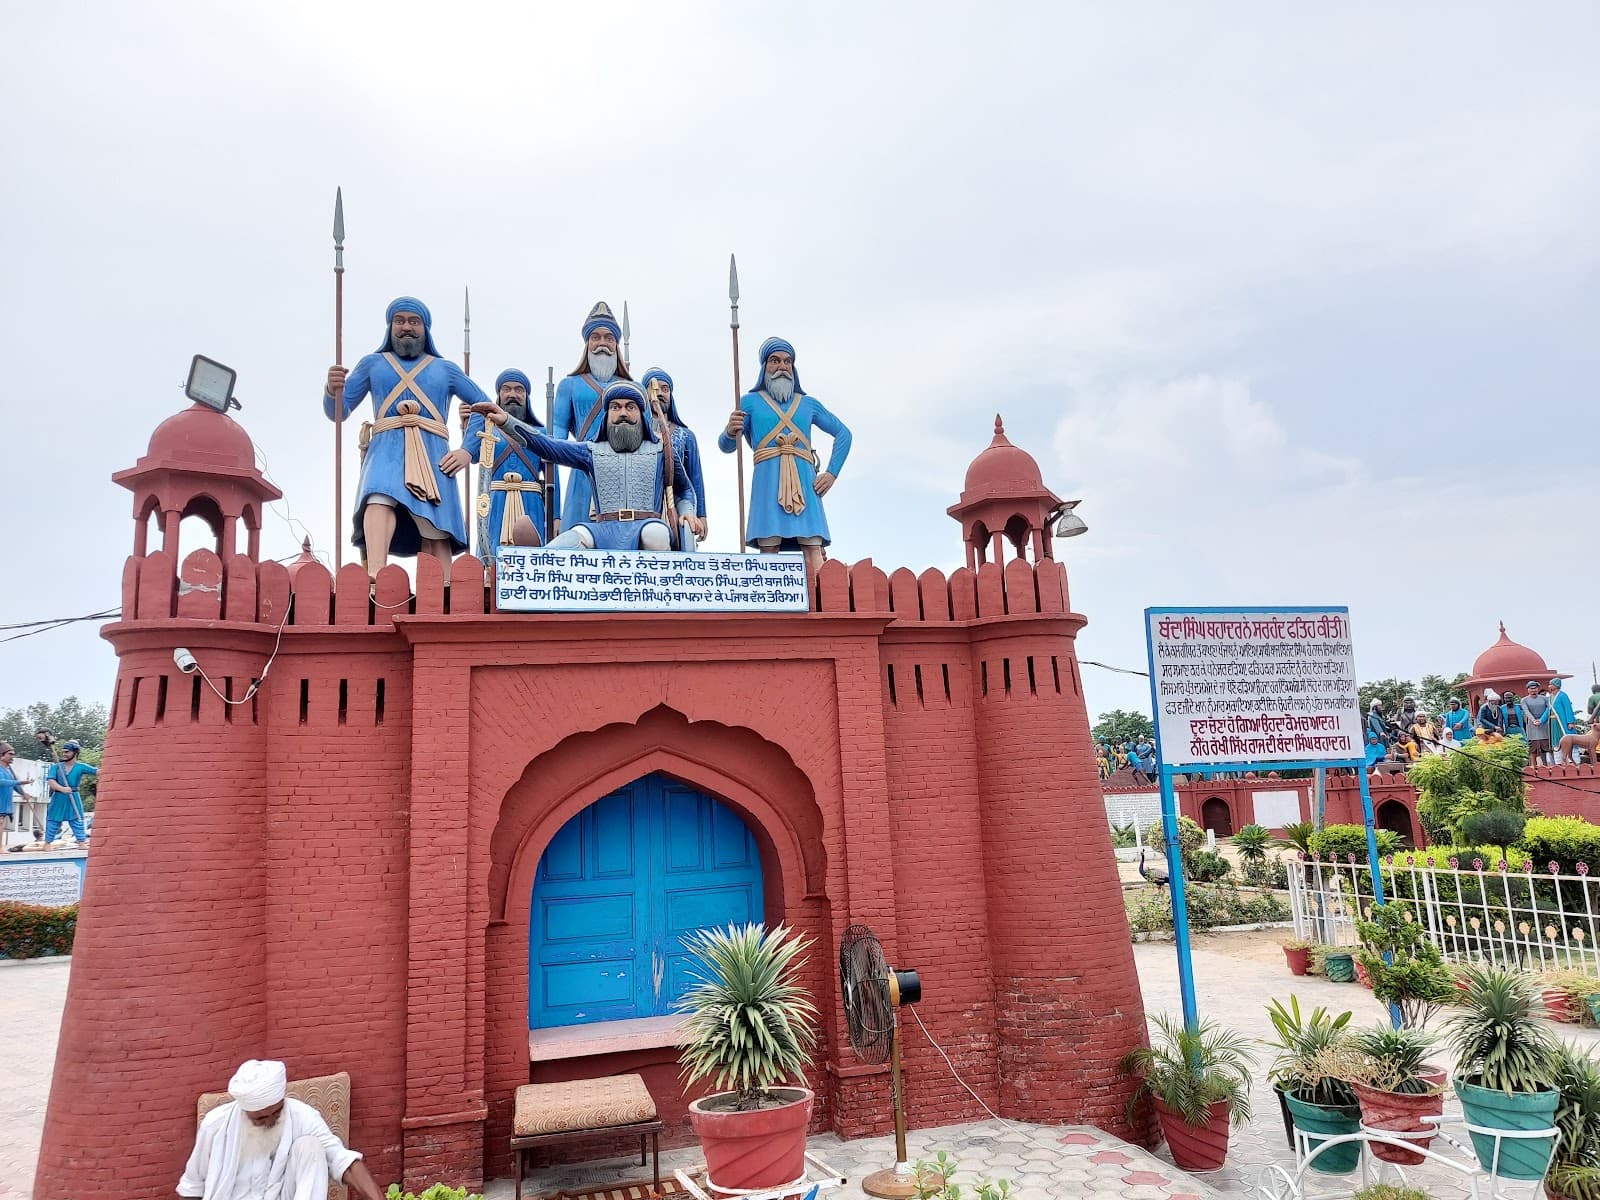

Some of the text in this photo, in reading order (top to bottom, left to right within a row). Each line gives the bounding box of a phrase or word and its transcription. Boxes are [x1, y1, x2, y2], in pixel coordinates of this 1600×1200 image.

[503, 554, 526, 569] ਗੁਰੂ
[530, 553, 566, 567] ਗੋਬਿੰਦ
[570, 554, 598, 568] ਸਿੰਘ
[602, 555, 616, 568] ਜੀ
[618, 555, 631, 569] ਨੇ
[635, 556, 670, 570] ਨੰਦੇੜ
[672, 557, 706, 571] ਸਾਹਿਬ
[721, 559, 744, 571] ਬੰਦਾ
[745, 559, 768, 571] ਸਿੰਘ
[769, 562, 803, 572] ਬਹਾਦਰ
[501, 569, 524, 582] ਅਤੇ
[526, 569, 546, 583] ਪੰਜ
[548, 570, 573, 583] ਸਿੰਘ
[576, 573, 601, 584] ਬਾਬਾ
[602, 571, 633, 585] ਬਿਨੋਦ
[660, 573, 684, 586] ਭਾਈ
[685, 576, 714, 587] ਕਾਹਨ
[764, 577, 783, 587] ਬਾਜ
[783, 575, 803, 587] ਸਿੰਘ
[500, 585, 527, 600] ਭਾਈ
[529, 588, 551, 600] ਰਾਮ
[553, 586, 579, 600] ਸਿੰਘ
[642, 588, 663, 602] ਸਿੰਘ
[704, 590, 713, 602] ਦੇ
[714, 590, 724, 602] ਕੇ
[724, 589, 749, 602] ਪੰਜਾਬ
[750, 590, 766, 602] ਵੱਲ
[1159, 616, 1182, 640] ਬੰਦਾ
[1183, 616, 1206, 640] ਸਿੰਘ
[1207, 621, 1242, 640] ਬਹਾਦਰ
[1252, 617, 1285, 639] ਸਰਹੰਦ
[1287, 616, 1316, 639] ਫਤਿਹ
[1236, 715, 1261, 733] ਗਿਆ
[1261, 713, 1285, 735] ਉਹਦਾ
[1229, 736, 1248, 754] ਸਿੱਖ
[1248, 738, 1265, 754] ਰਾਜ
[1265, 734, 1276, 753] ਦੀ
[1276, 734, 1294, 752] ਬੰਦਾ
[1294, 733, 1314, 752] ਸਿੰਘ
